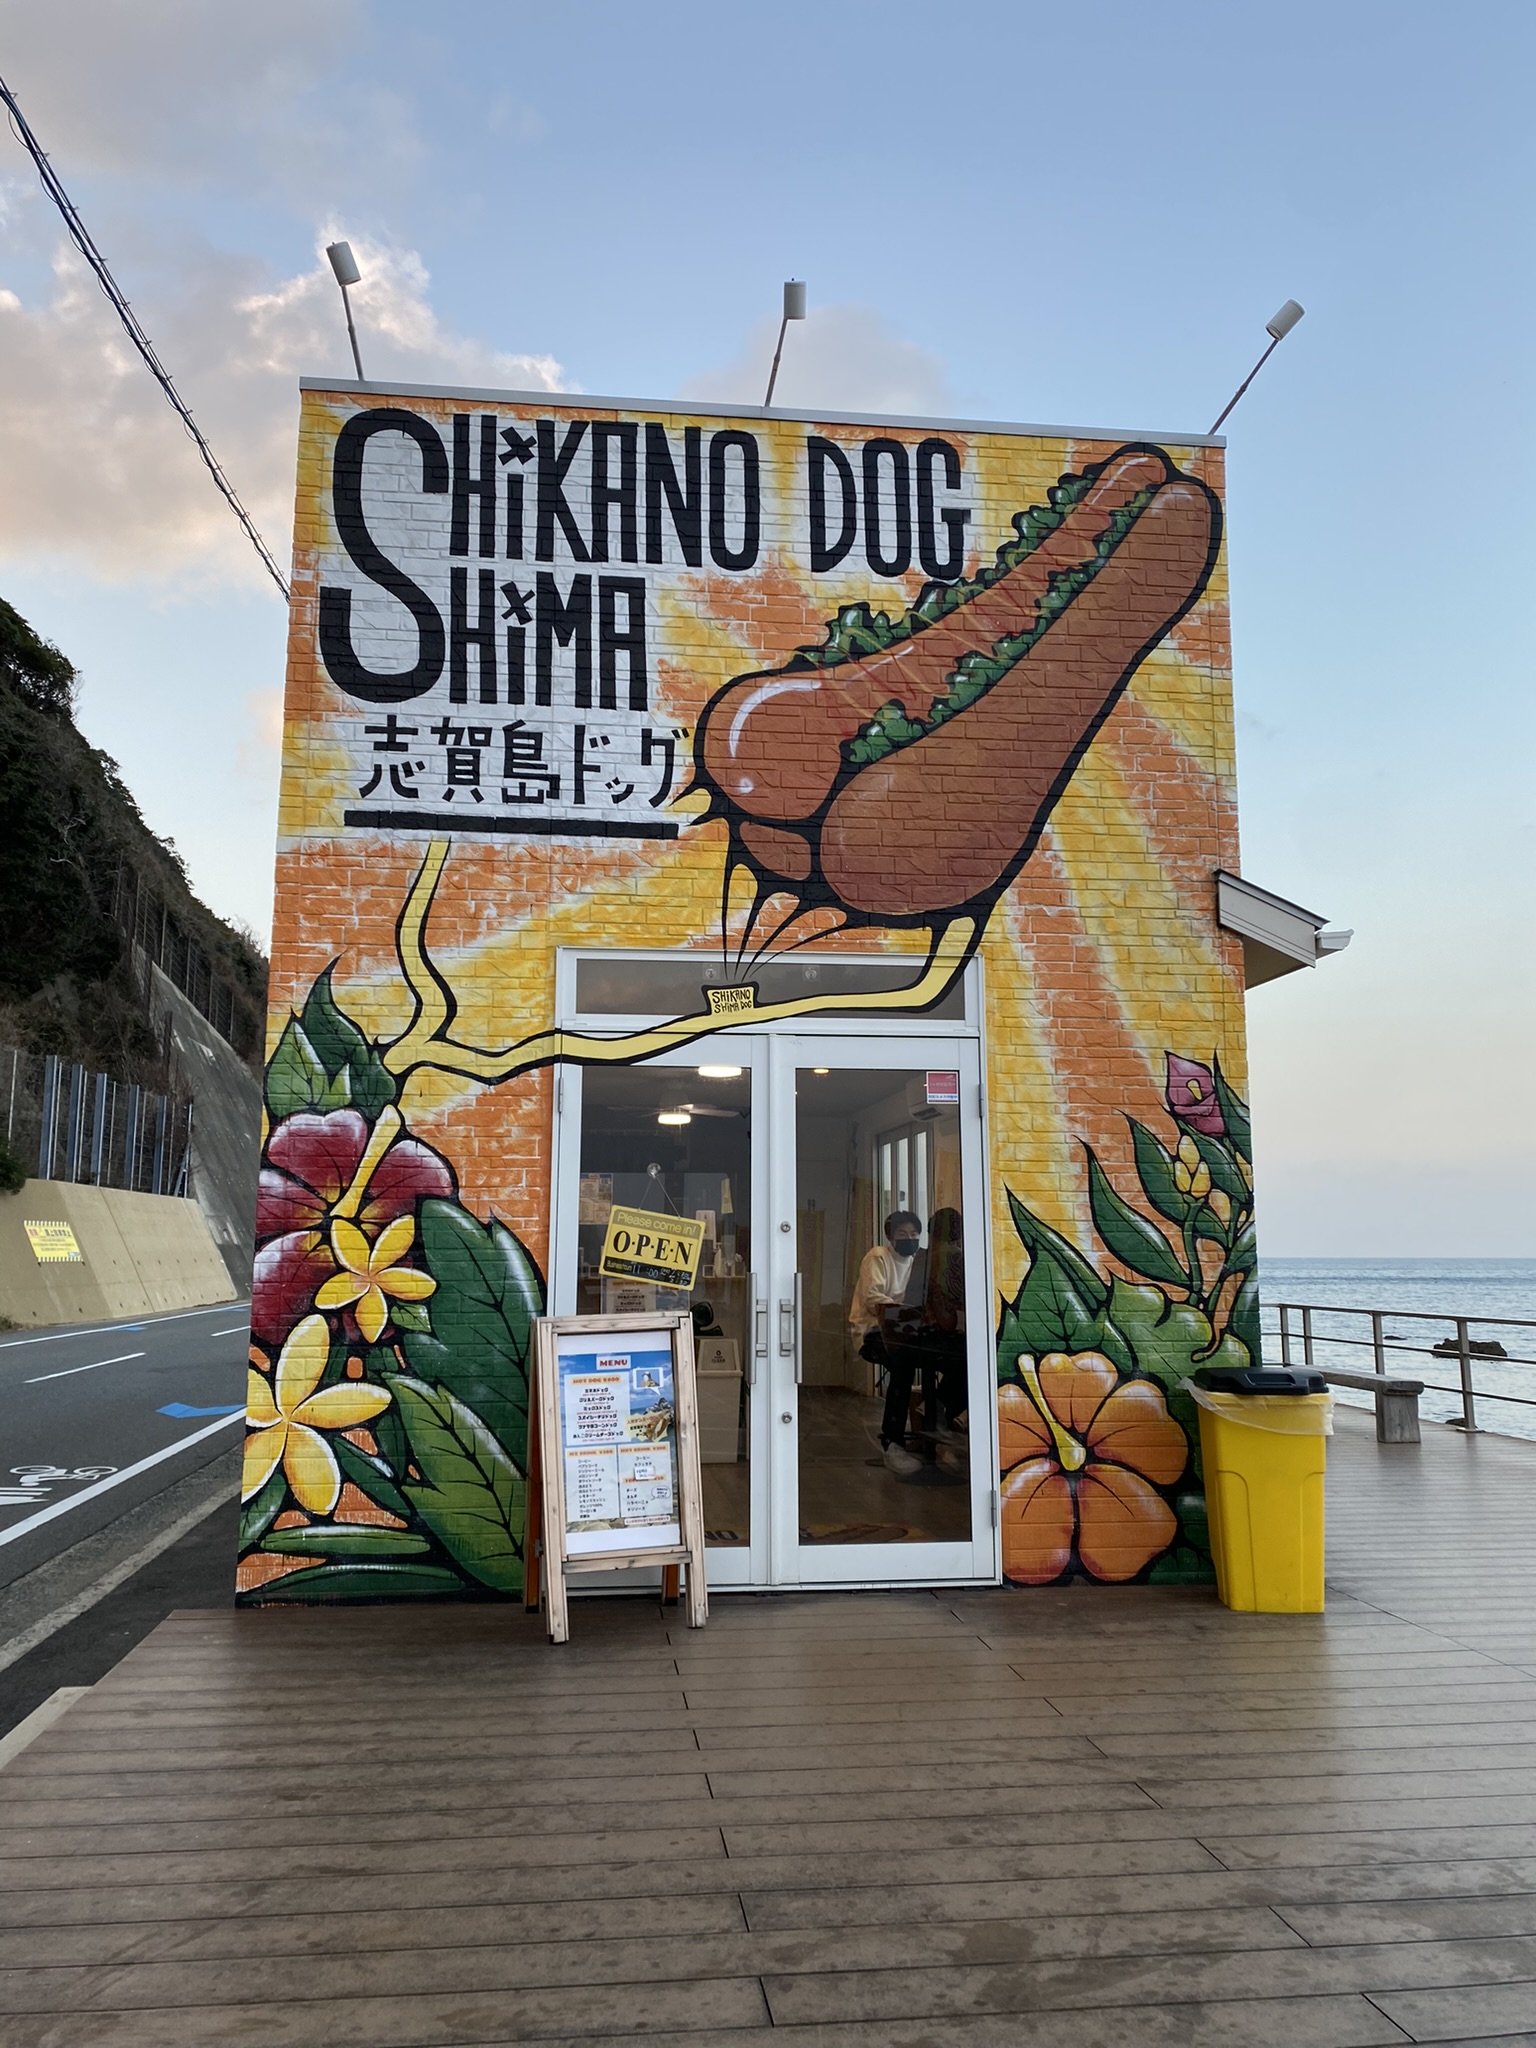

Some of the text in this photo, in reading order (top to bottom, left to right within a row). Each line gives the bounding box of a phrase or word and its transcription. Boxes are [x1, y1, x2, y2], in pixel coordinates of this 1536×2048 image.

[807, 435, 971, 580] DOG
[359, 714, 690, 808] 志賀島ドッグ
[617, 1212, 697, 1236] Please come in!
[599, 1359, 628, 1367] MENU
